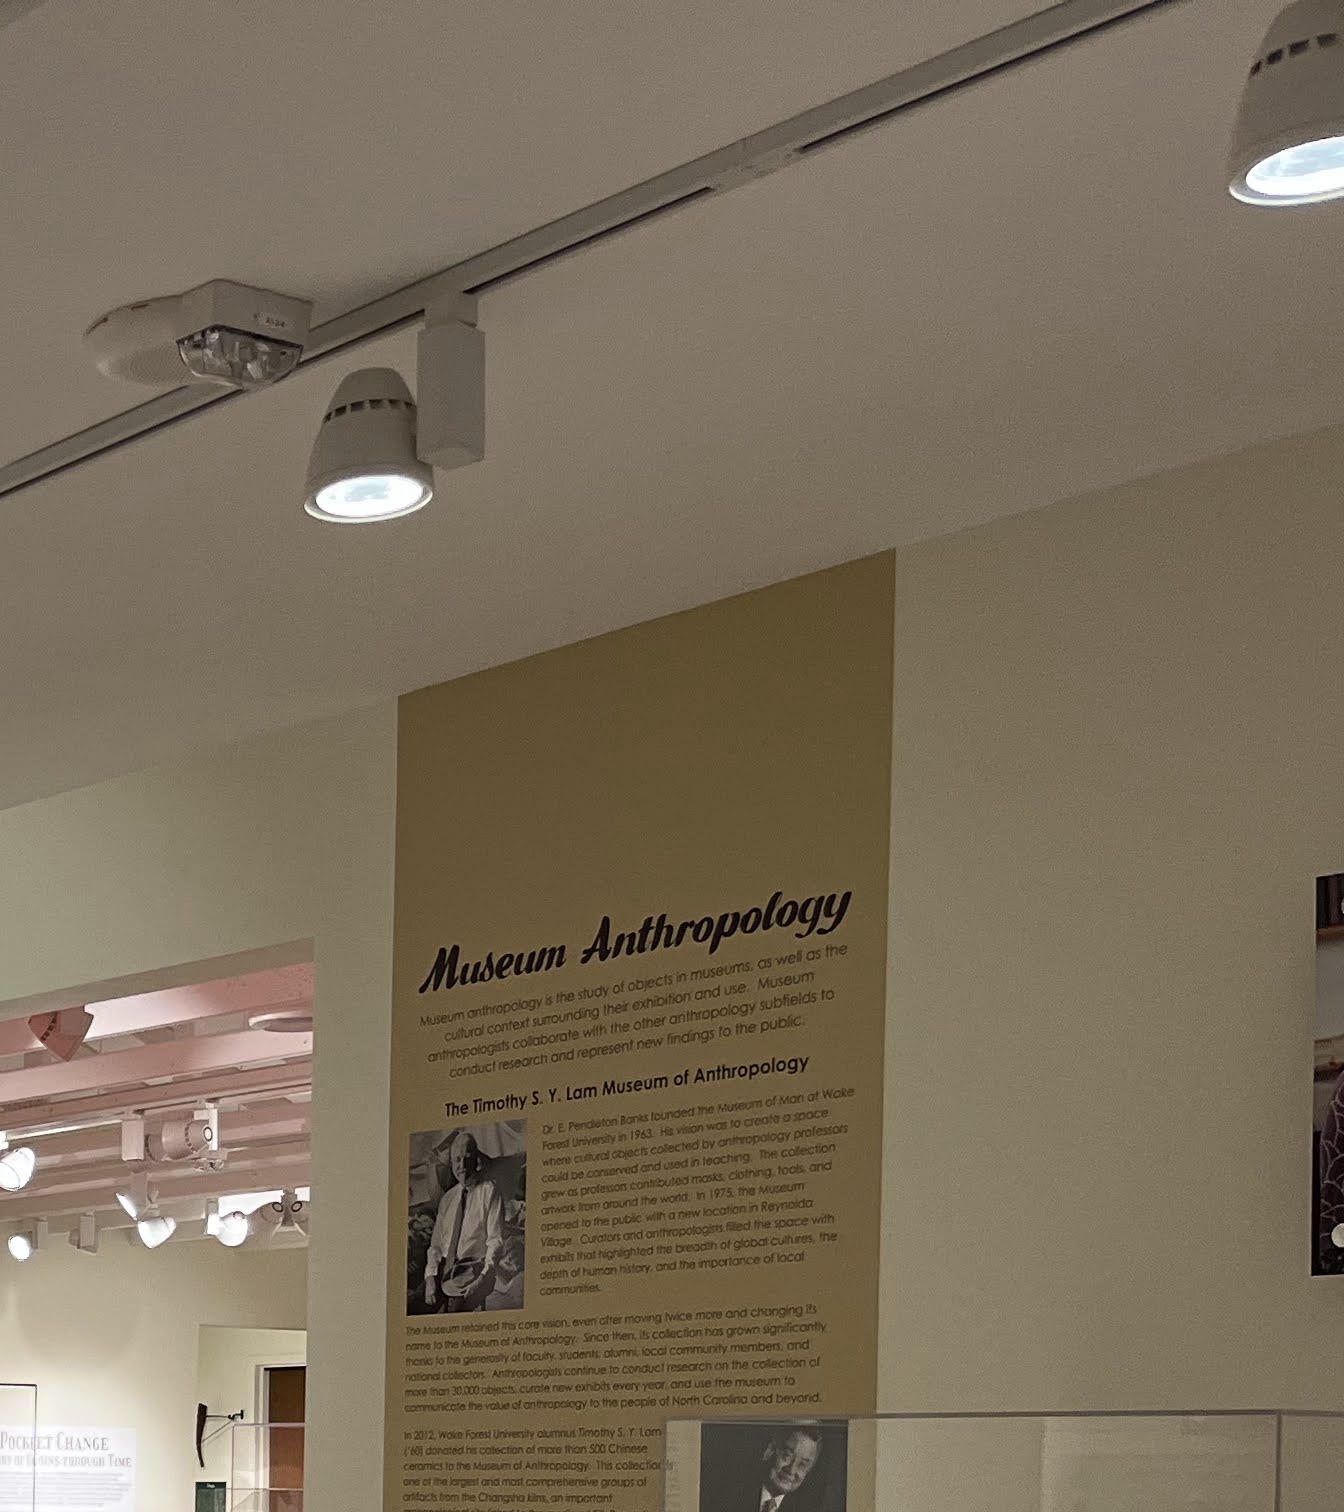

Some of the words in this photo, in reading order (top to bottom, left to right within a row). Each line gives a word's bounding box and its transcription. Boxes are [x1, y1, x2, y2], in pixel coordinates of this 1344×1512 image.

[418, 944, 567, 994] Museum
[580, 890, 853, 965] Anthropology
[420, 1012, 464, 1026] Museum
[467, 998, 543, 1019] anthropology
[545, 995, 553, 1005] is
[556, 990, 575, 1003] the
[578, 984, 609, 1002] study
[614, 980, 625, 994] of
[628, 972, 673, 991] objects
[676, 970, 687, 983] in
[757, 958, 772, 970] as
[775, 949, 802, 967] well
[806, 951, 822, 961] as
[825, 943, 848, 957] the
[444, 1024, 485, 1042] cultural
[487, 1017, 530, 1034] context
[532, 1007, 599, 1027] surrounding
[603, 1003, 629, 1016] their
[632, 991, 691, 1011] exhibition
[694, 984, 720, 1000] and
[724, 983, 750, 995] use.
[757, 972, 815, 990] Museum
[428, 1044, 509, 1063] anthropologists
[512, 1029, 579, 1050] collaborate
[583, 1025, 607, 1038] with
[611, 1022, 630, 1033] the
[633, 1015, 665, 1029] other
[669, 1001, 756, 1024] anthropology
[759, 990, 817, 1010] subfields
[821, 988, 834, 1000] to
[449, 1061, 496, 1078] conduct
[498, 1053, 547, 1071] research
[551, 1048, 574, 1062] and
[576, 1039, 632, 1060] represent
[637, 1038, 662, 1050] new
[667, 1028, 714, 1045] findings
[719, 1026, 731, 1038] to
[736, 1022, 756, 1034] the
[760, 1015, 806, 1033] public.
[445, 1103, 468, 1117] The
[473, 1094, 527, 1112] Timothy
[531, 1091, 543, 1105] S.
[548, 1088, 561, 1103] Y.
[566, 1085, 597, 1101] Lam
[602, 1075, 669, 1097] Museum
[673, 1069, 689, 1086] of
[693, 1056, 811, 1084] Anthropology
[542, 1139, 569, 1150] Forest
[572, 1133, 616, 1148] University
[618, 1133, 627, 1142] in
[676, 1124, 703, 1135] vision
[706, 1120, 727, 1130] was
[730, 1118, 740, 1128] to
[744, 1114, 779, 1127] create
[783, 1114, 791, 1122] a
[794, 1109, 829, 1122] space
[542, 1156, 571, 1167] where
[574, 1150, 610, 1164] cultural
[612, 1146, 648, 1160] objects
[651, 1140, 699, 1155] collected
[702, 1138, 715, 1150] by
[718, 1130, 791, 1148] anthropology
[794, 1123, 848, 1141] professors
[541, 1172, 568, 1183] could
[571, 1169, 584, 1179] be
[640, 1161, 661, 1172] and
[664, 1158, 688, 1171] used
[690, 1157, 699, 1167] in
[759, 1148, 777, 1159] The
[781, 1143, 836, 1158] collection
